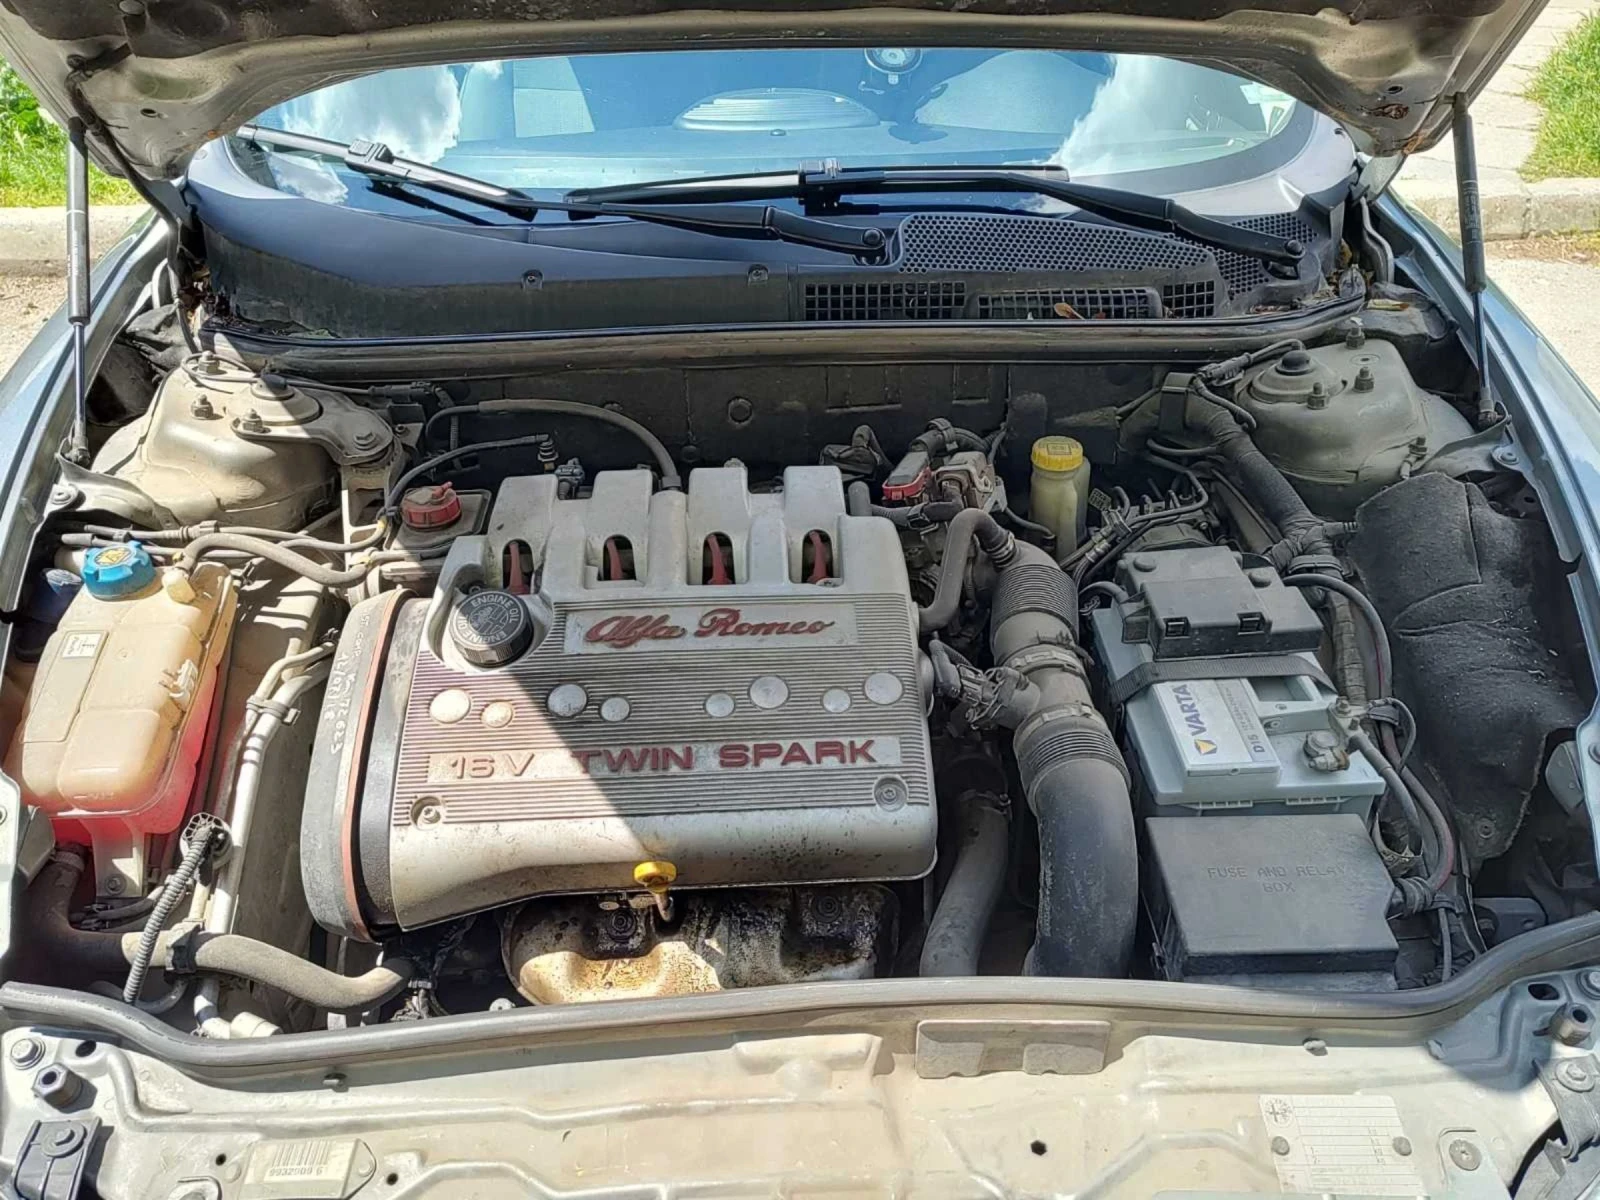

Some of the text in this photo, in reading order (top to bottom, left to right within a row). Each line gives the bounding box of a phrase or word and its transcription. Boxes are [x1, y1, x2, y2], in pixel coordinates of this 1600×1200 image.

[470, 594, 520, 623] ENGINE OIL
[457, 614, 507, 643] ENGINE OIL
[584, 607, 835, 649] Alfa Romeo
[1172, 684, 1207, 736] VARTA
[570, 746, 693, 774] TWIN
[719, 740, 877, 768] SPARK
[1247, 734, 1265, 753] D15
[1207, 864, 1345, 879] FUSE AND RELAY
[1262, 881, 1296, 893] BOX
